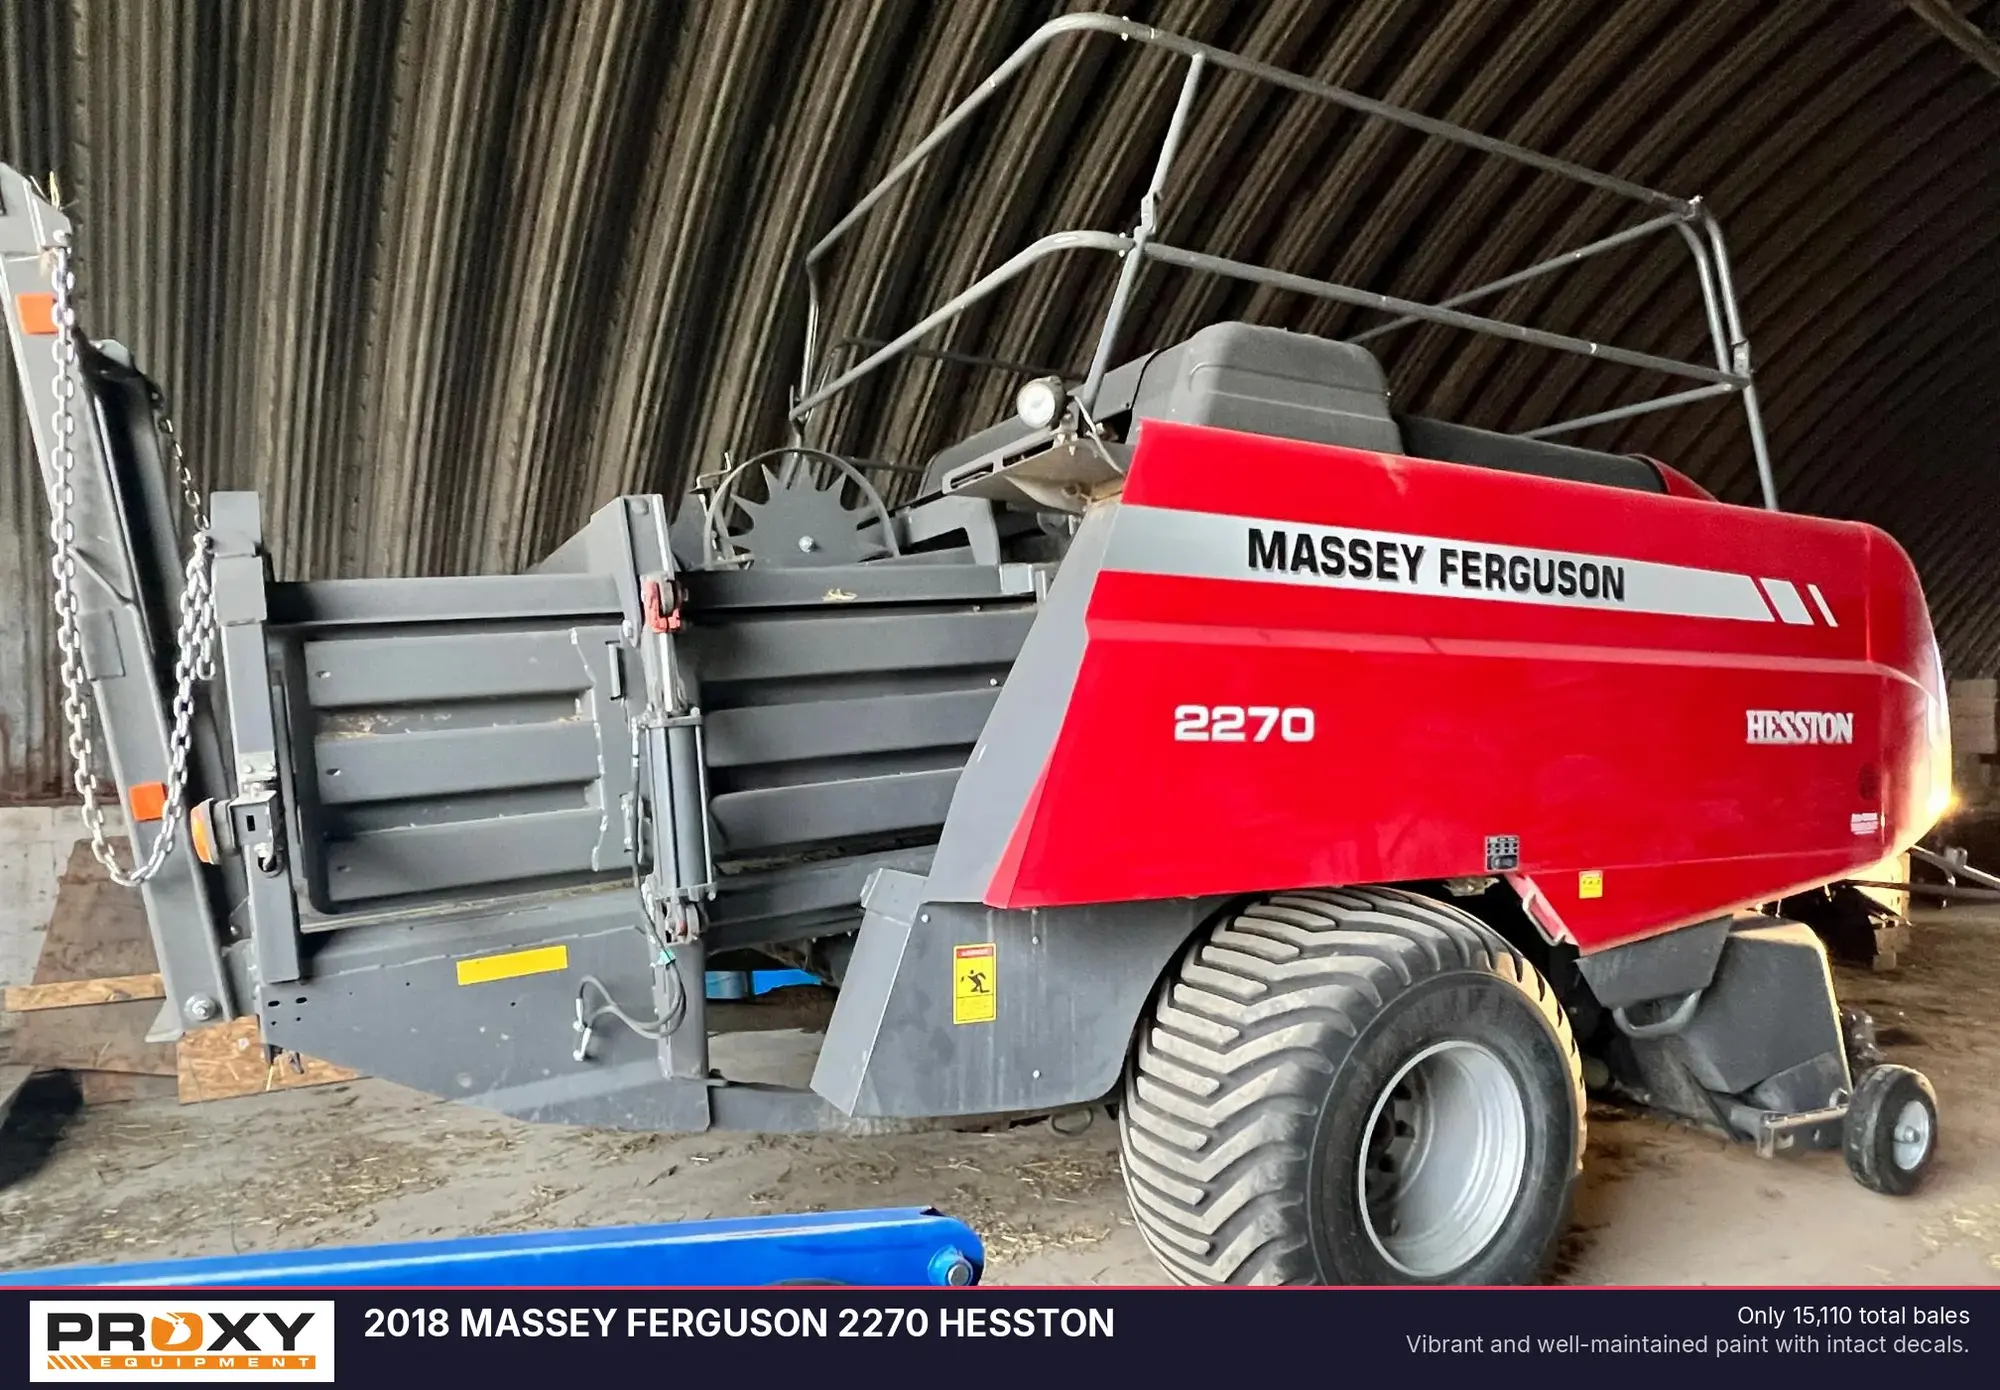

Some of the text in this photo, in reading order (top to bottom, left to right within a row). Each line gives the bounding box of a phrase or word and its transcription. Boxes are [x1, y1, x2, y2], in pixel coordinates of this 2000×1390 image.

[1247, 527, 1626, 602] MASSEY FERGUSON
[1174, 704, 1315, 743] 2270
[1746, 709, 1854, 744] HESSTON
